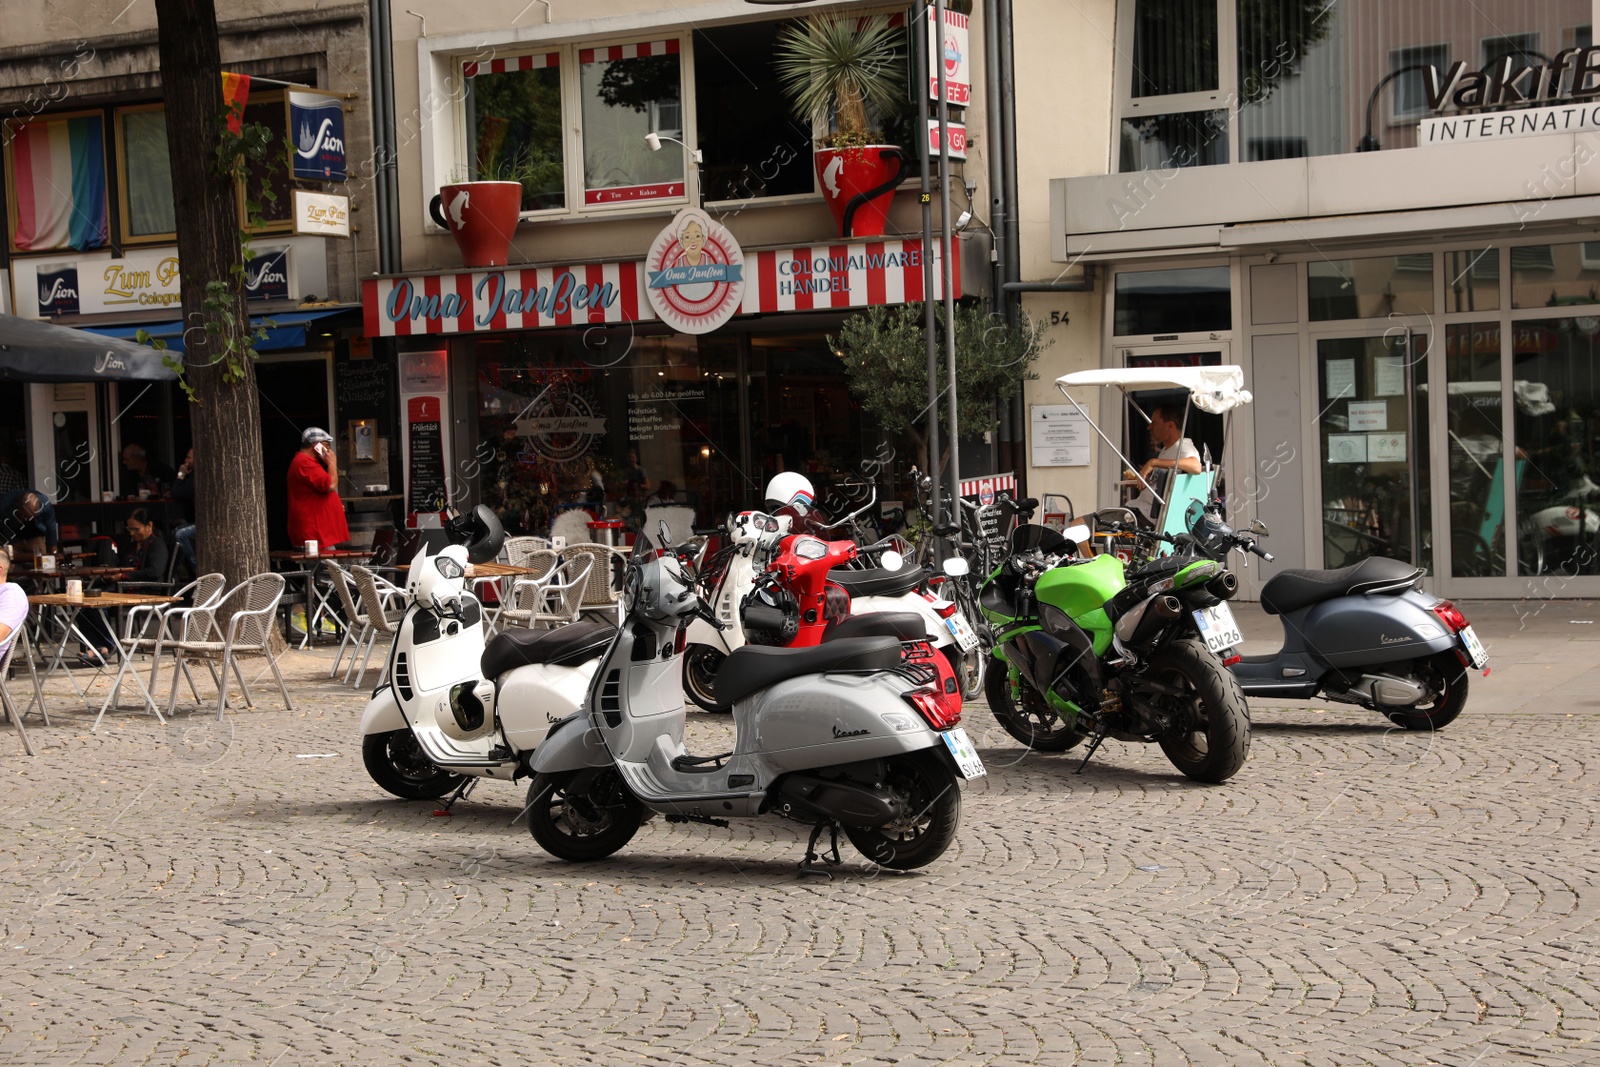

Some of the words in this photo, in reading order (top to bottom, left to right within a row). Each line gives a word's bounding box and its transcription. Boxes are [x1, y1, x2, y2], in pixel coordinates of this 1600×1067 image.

[931, 80, 961, 102] CFÉ
[297, 118, 345, 159] Sion
[953, 133, 965, 148] GO
[921, 193, 930, 202] 26
[307, 205, 327, 221] Zum
[246, 261, 286, 291] Sion
[665, 270, 687, 281] Oma
[688, 266, 725, 281] Janßen
[104, 265, 151, 298] Zum
[779, 276, 851, 296] HANDEL
[39, 277, 78, 306] Sion
[138, 291, 182, 307] Cologne
[386, 279, 468, 323] Oma
[475, 271, 619, 327] Janßen
[1050, 310, 1070, 326] 54
[94, 350, 126, 374] Sion
[651, 391, 664, 399] 6.00
[665, 390, 676, 398] Uhr
[677, 389, 705, 398] geöffnet
[628, 407, 657, 415] Frühstück
[412, 422, 438, 432] Frühstück
[552, 417, 588, 431] Janßen
[628, 416, 663, 424] Filterkaffee
[628, 425, 652, 434] belegte
[653, 423, 681, 431] Brötchen
[629, 432, 655, 441] Bäckerei
[1210, 608, 1221, 621] K
[832, 724, 871, 739] Vespa
[952, 731, 961, 744] K
